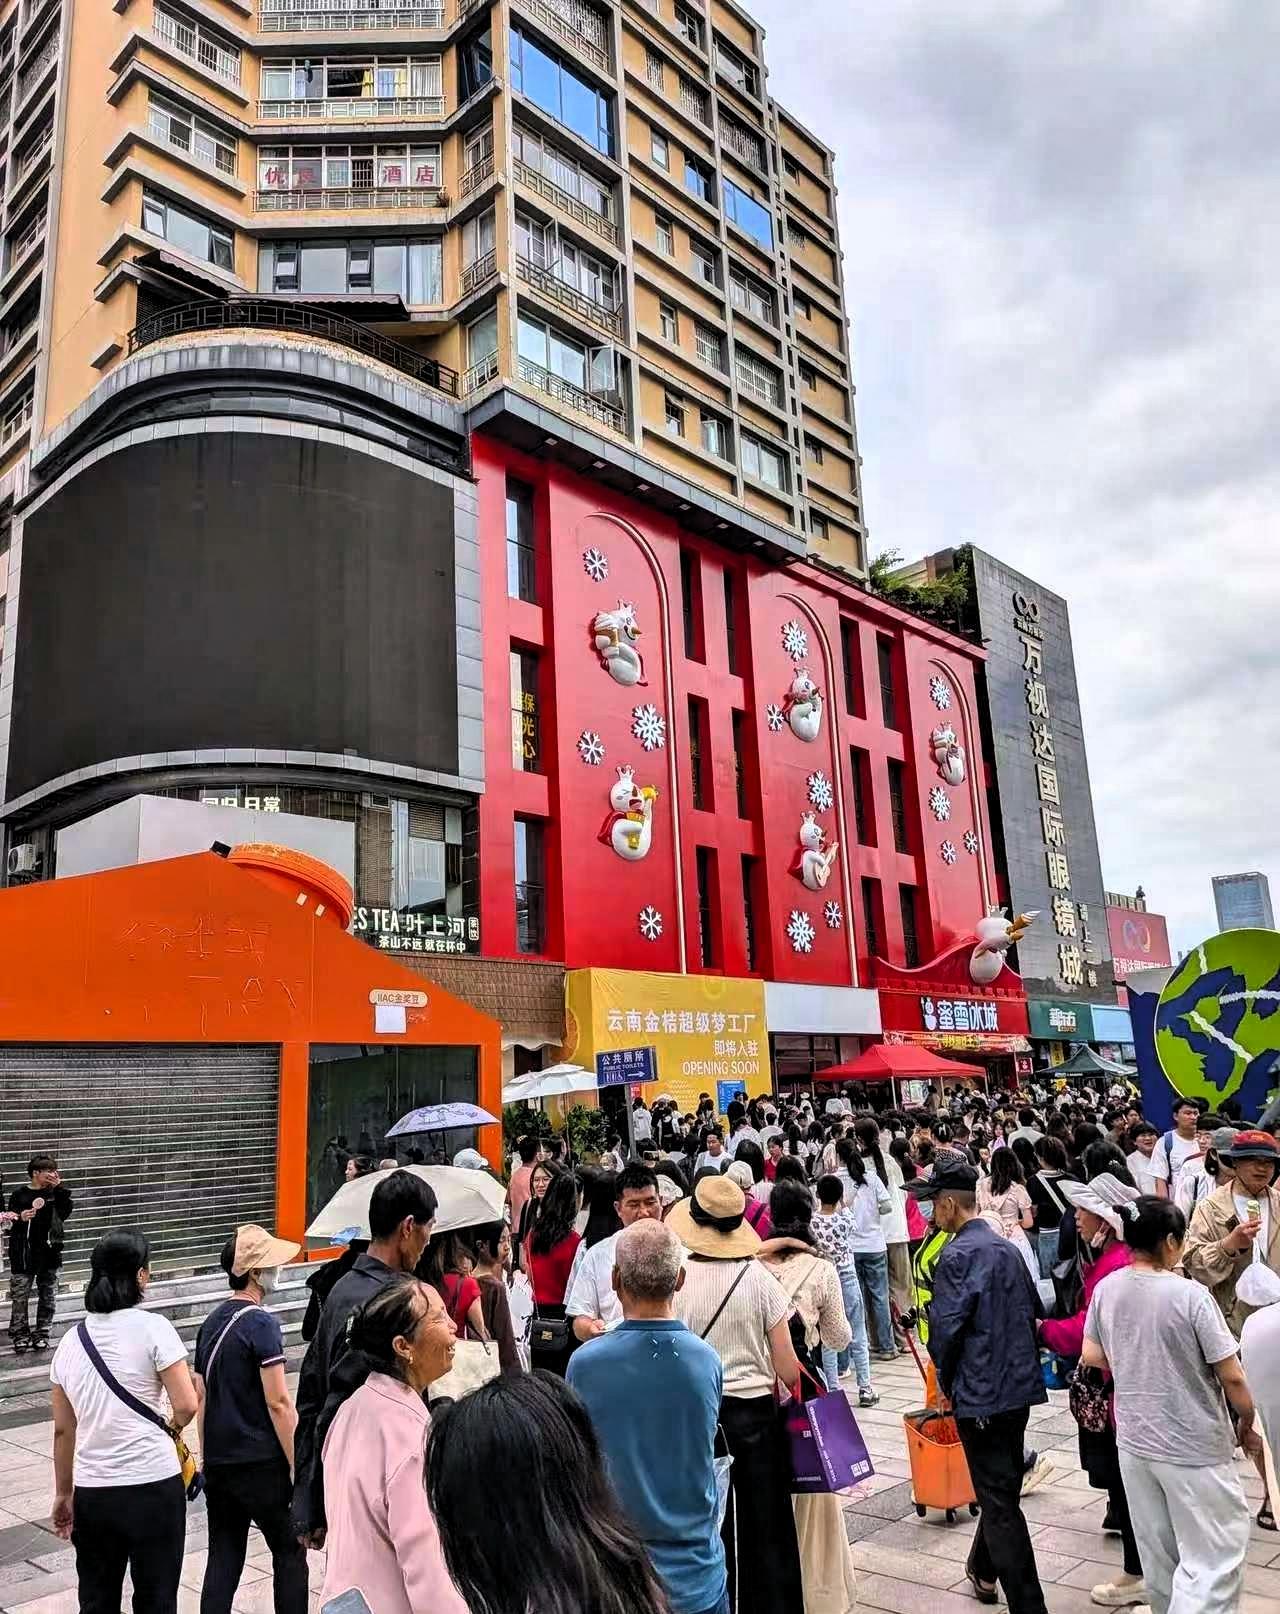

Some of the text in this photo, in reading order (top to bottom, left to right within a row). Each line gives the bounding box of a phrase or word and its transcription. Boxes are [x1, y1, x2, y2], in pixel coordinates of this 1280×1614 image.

[1020, 636, 1083, 985] 万视达国际眼镜城
[372, 908, 399, 932] TEA
[406, 914, 465, 938] 叶上河
[379, 936, 466, 953] 茶山不远 就在杯中
[608, 1009, 756, 1034] 云南金桔超级梦工厂
[938, 1000, 999, 1031] 蜜雪冰城
[602, 1050, 644, 1065] 公共厕所
[714, 1040, 758, 1057] 即将入驻
[622, 1062, 644, 1070] TOILETS
[682, 1060, 760, 1076] OPENING SOON
